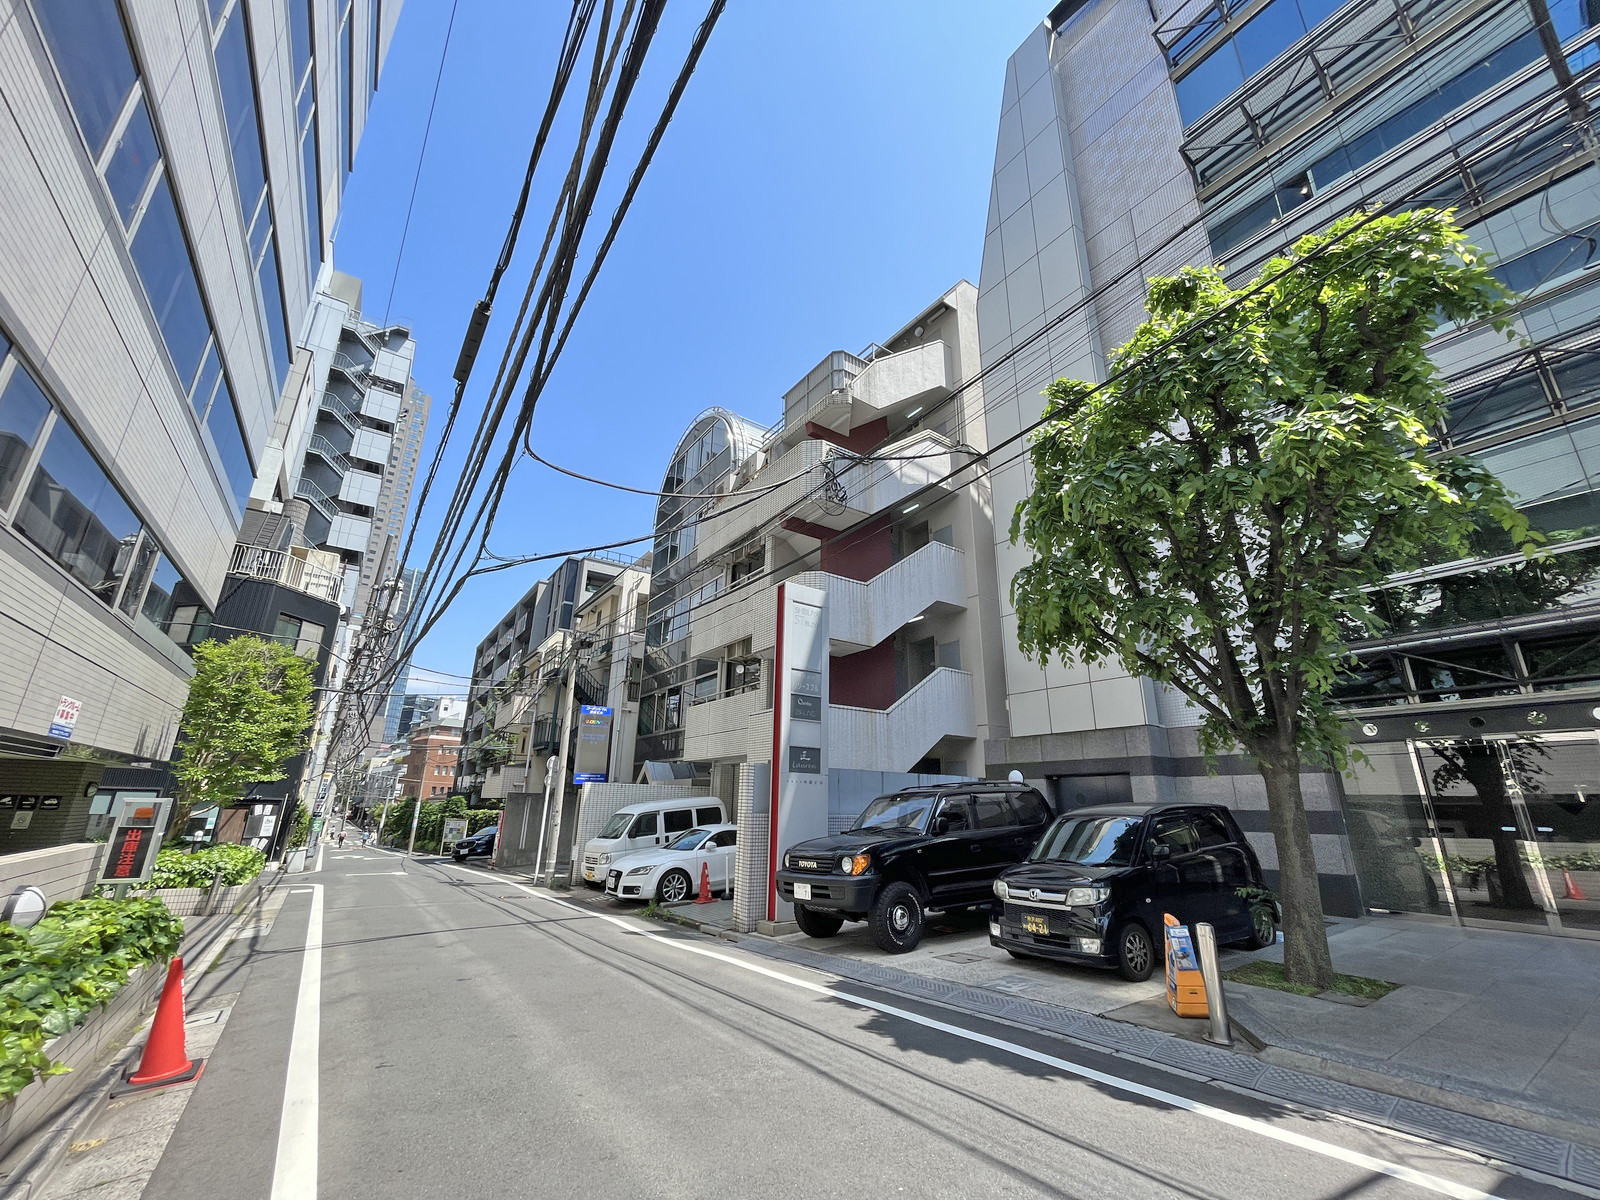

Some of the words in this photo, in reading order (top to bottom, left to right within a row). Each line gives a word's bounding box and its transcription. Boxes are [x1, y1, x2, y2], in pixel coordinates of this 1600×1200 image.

[113, 828, 142, 878] 出庫注意
[798, 860, 818, 869] TOYOTA
